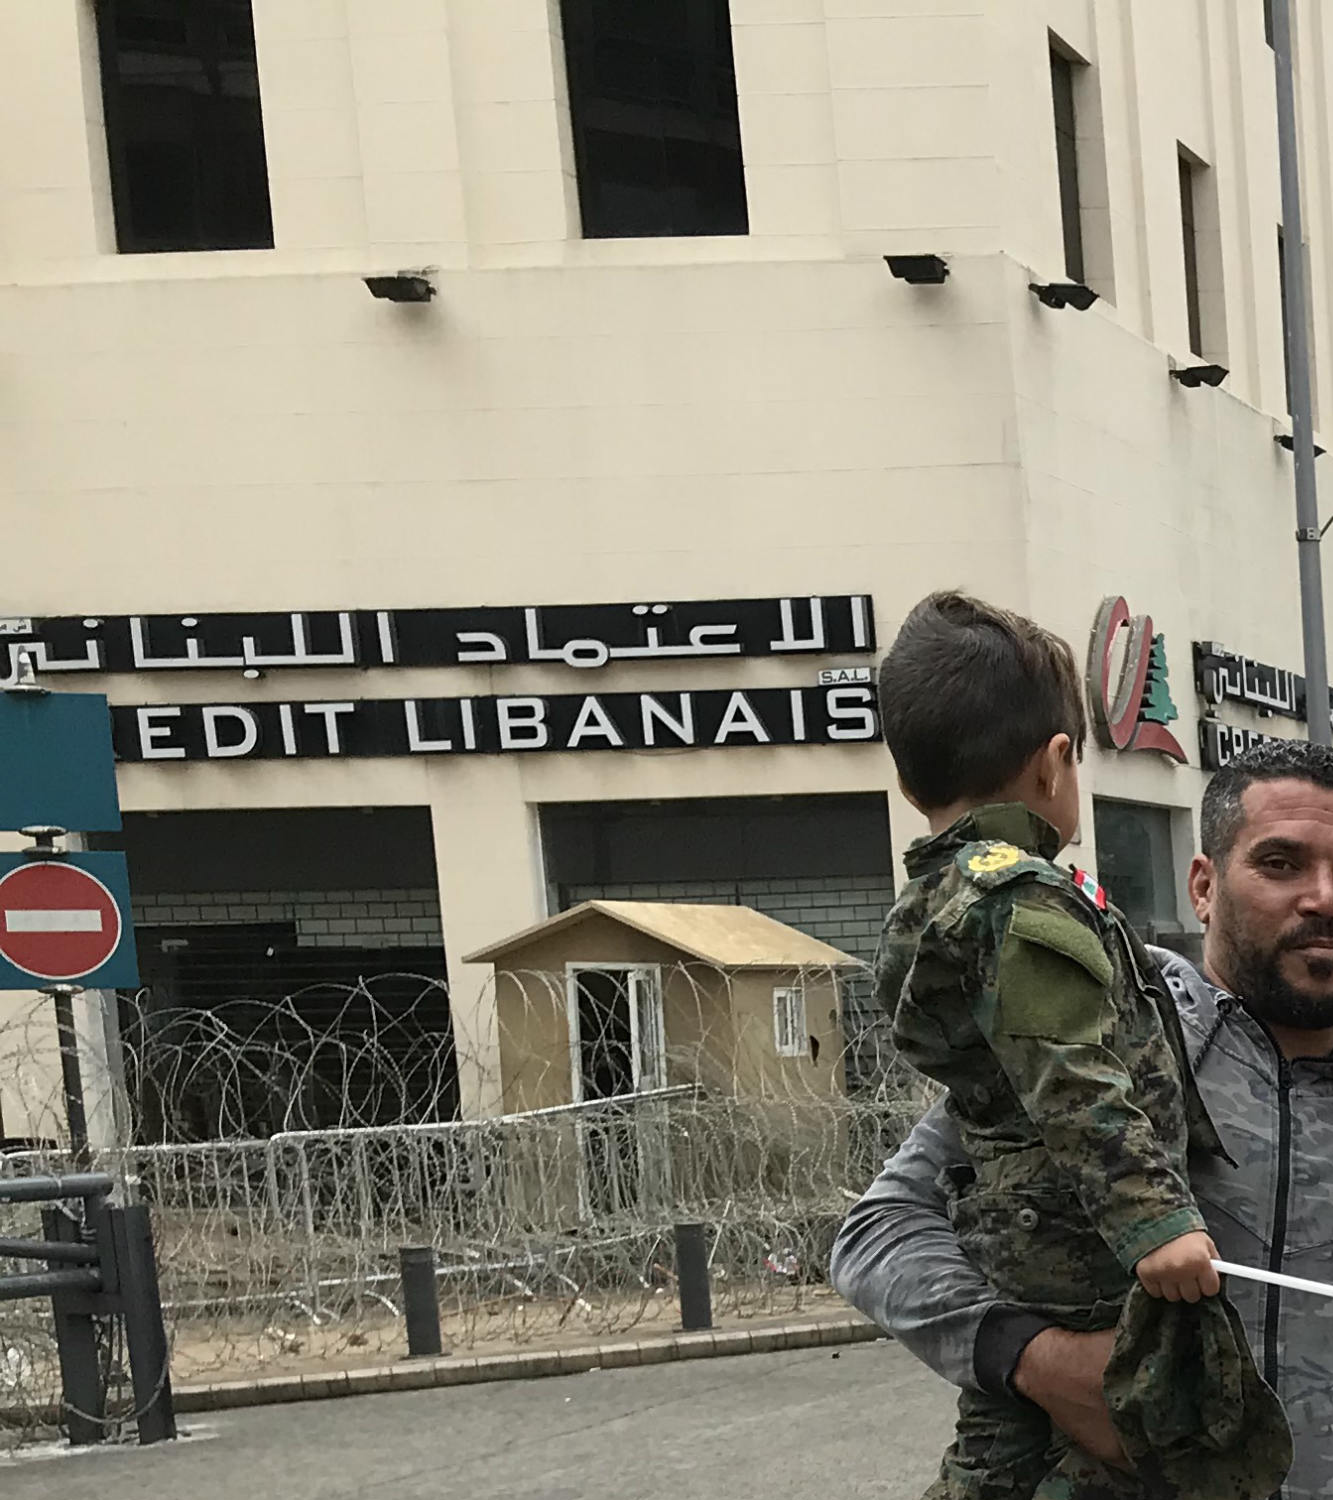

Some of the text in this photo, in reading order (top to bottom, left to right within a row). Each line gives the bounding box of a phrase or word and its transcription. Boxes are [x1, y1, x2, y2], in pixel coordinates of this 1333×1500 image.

[456, 597, 866, 668] الاعتماد
[821, 669, 869, 684] S.A.L.
[137, 687, 875, 759] EDIT LIBANAIS
